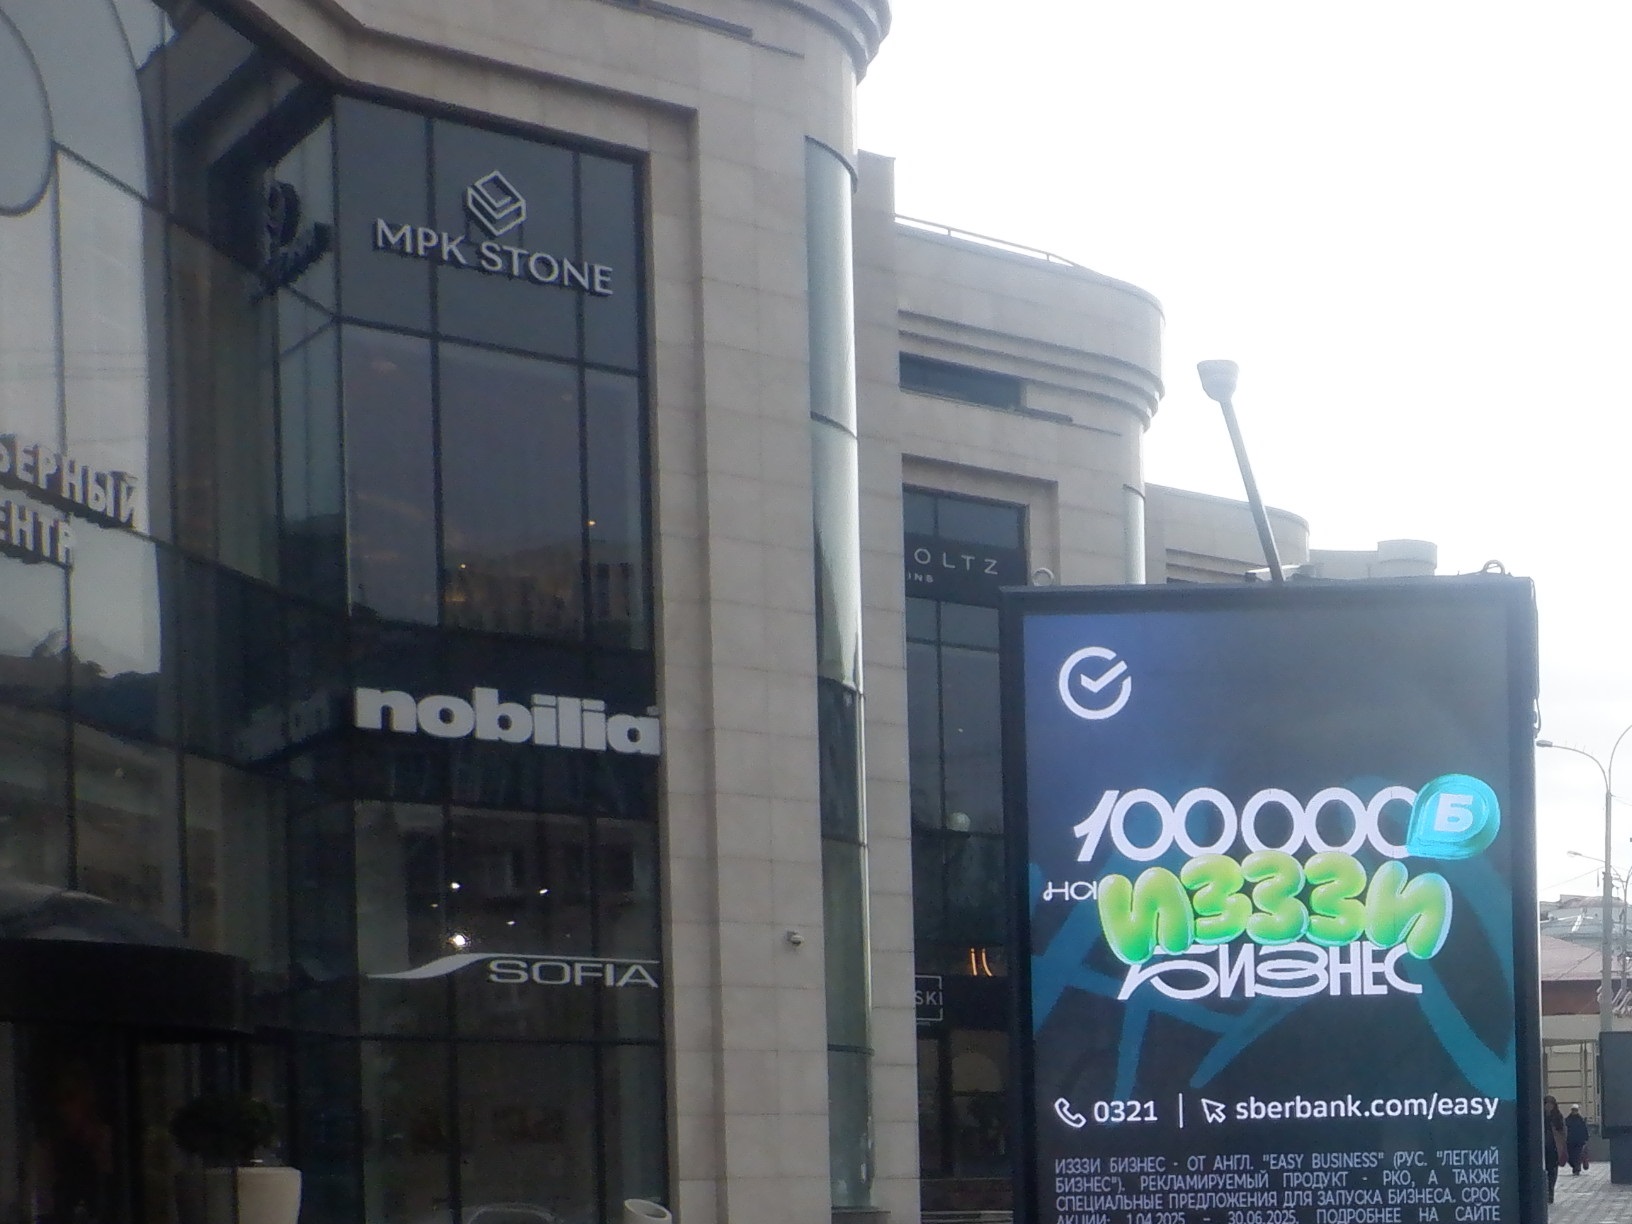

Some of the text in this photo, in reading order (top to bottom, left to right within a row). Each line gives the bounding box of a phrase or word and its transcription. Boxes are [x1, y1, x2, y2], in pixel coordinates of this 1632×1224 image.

[375, 217, 614, 296] MPK STONE
[354, 686, 661, 756] nobilia
[489, 959, 659, 989] SOFIA
[1093, 1093, 1498, 1122] 0321 sberbank.com/easy
[1110, 1156, 1165, 1173] БИЗНЕС
[1187, 1155, 1206, 1171] ОТ
[1213, 1154, 1254, 1171] АНГЛ.
[1263, 1153, 1304, 1170] "EASY
[1311, 1151, 1384, 1169] BUSINESS"
[1393, 1151, 1427, 1169] (РУС.
[1437, 1146, 1499, 1166] "ЛЕГКИЙ
[1055, 1176, 1125, 1193] БИЗНЕС").
[1141, 1171, 1269, 1191] РЕКЛАМИРУЕМЫЙ
[1283, 1172, 1348, 1189] ПРОДУКТ
[1383, 1170, 1416, 1188] РКО,
[1428, 1169, 1438, 1185] А
[1452, 1168, 1499, 1184] ТАКЖЕ
[1056, 1187, 1500, 1213] СПЕЦИАЛЬНЫЕ ПРЕДЛОЖЕНИЯ ДЛЯ ЗАПУСКА БИЗНЕСА. СРОК
[1316, 1208, 1401, 1224] ПОДРОБНЕЕ
[1419, 1206, 1438, 1222] НА
[1455, 1202, 1500, 1221] САЙТЕ
